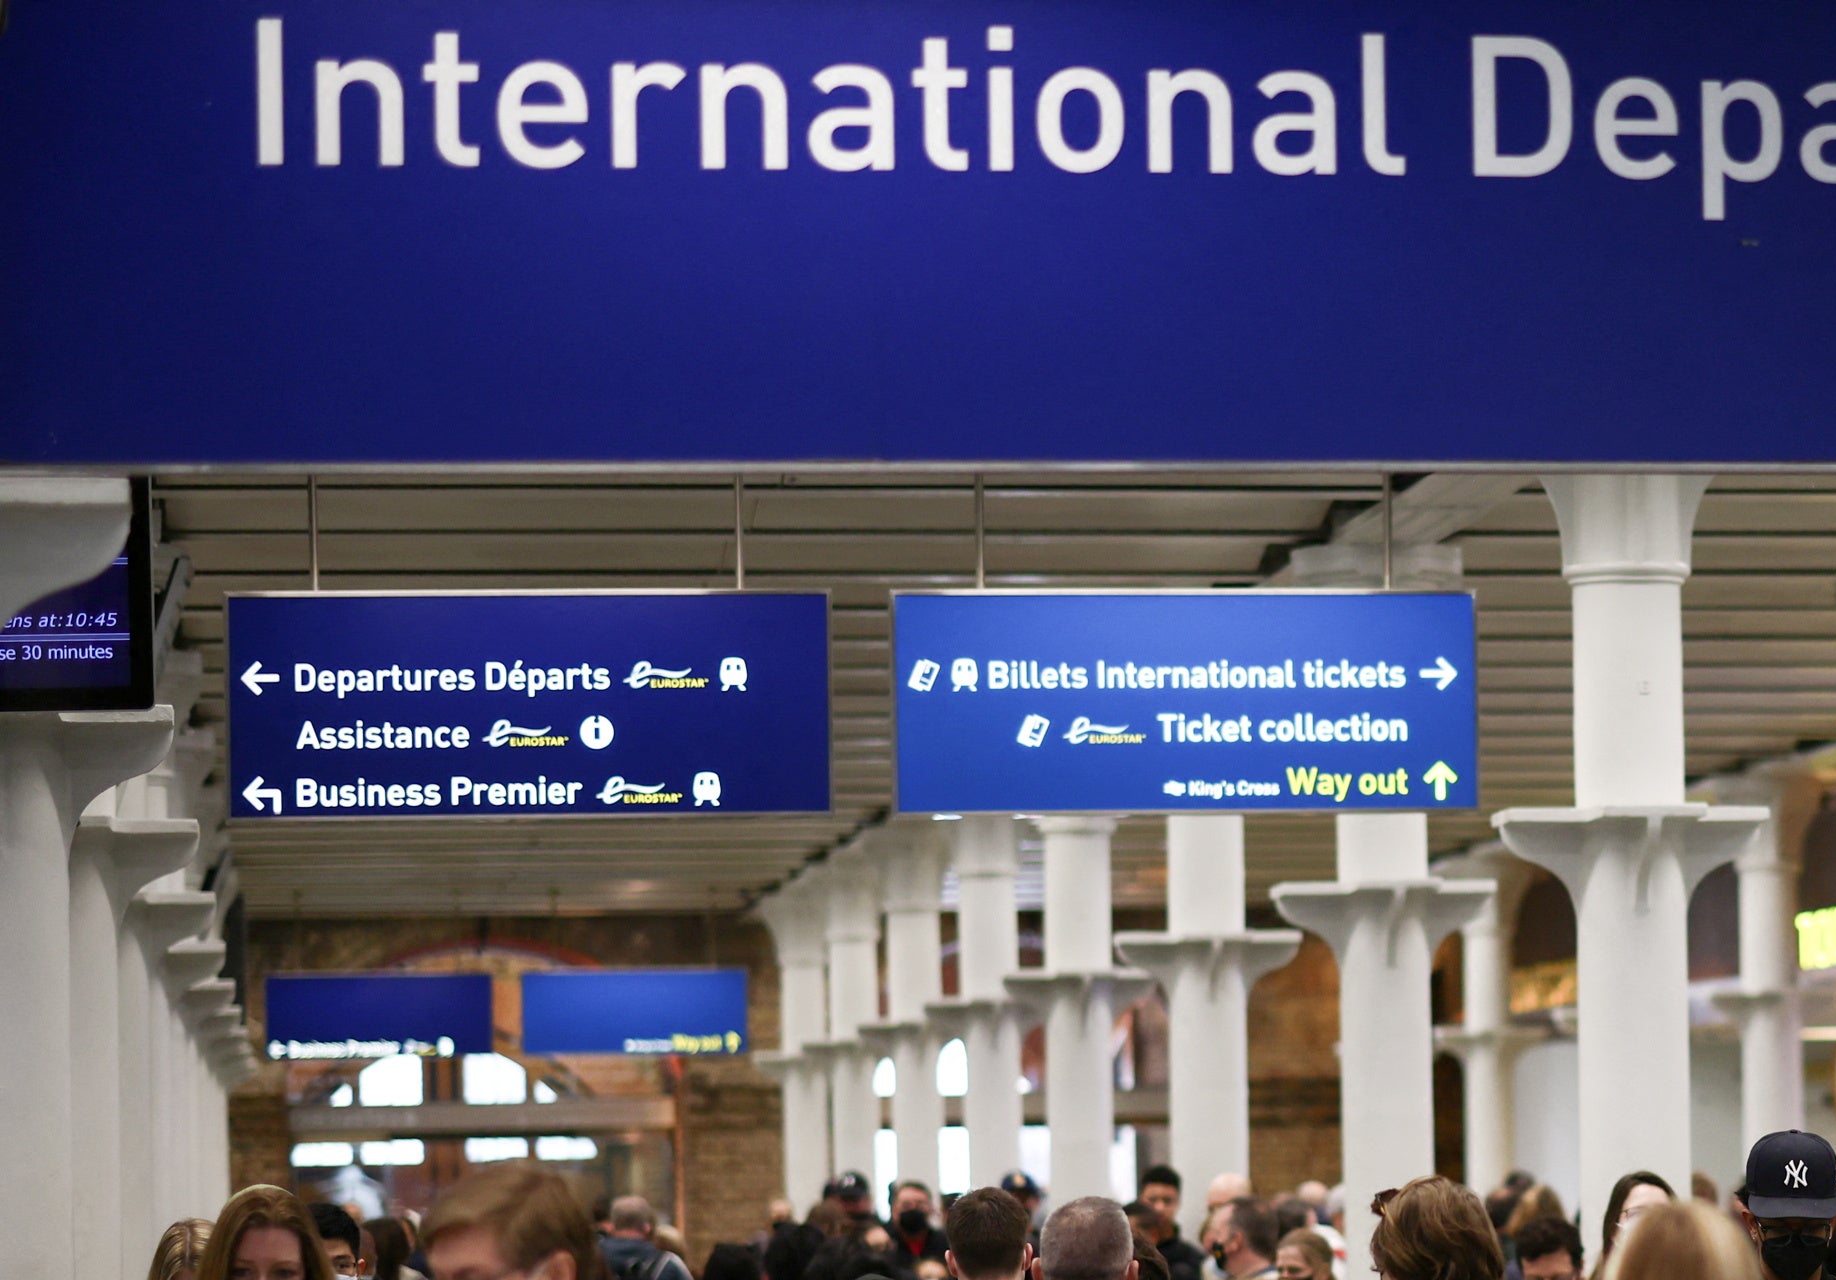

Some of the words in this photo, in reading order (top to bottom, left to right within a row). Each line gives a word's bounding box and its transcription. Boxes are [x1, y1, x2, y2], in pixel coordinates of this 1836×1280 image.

[257, 18, 1406, 176] International
[22, 645, 42, 660] 30
[48, 644, 113, 659] minutes
[294, 663, 476, 699] Departures
[484, 659, 611, 698] Départs
[986, 659, 1089, 690] Billets
[1095, 657, 1298, 691] International
[1301, 657, 1407, 689] tickets
[296, 718, 470, 750] Assistance
[1155, 711, 1253, 744] Ticket
[1257, 711, 1409, 743] collection
[295, 777, 442, 808] Business
[450, 775, 584, 806] Premier
[1187, 780, 1235, 800] King's
[1235, 780, 1281, 797] Cross
[1285, 766, 1353, 803] Way
[1357, 767, 1409, 796] out
